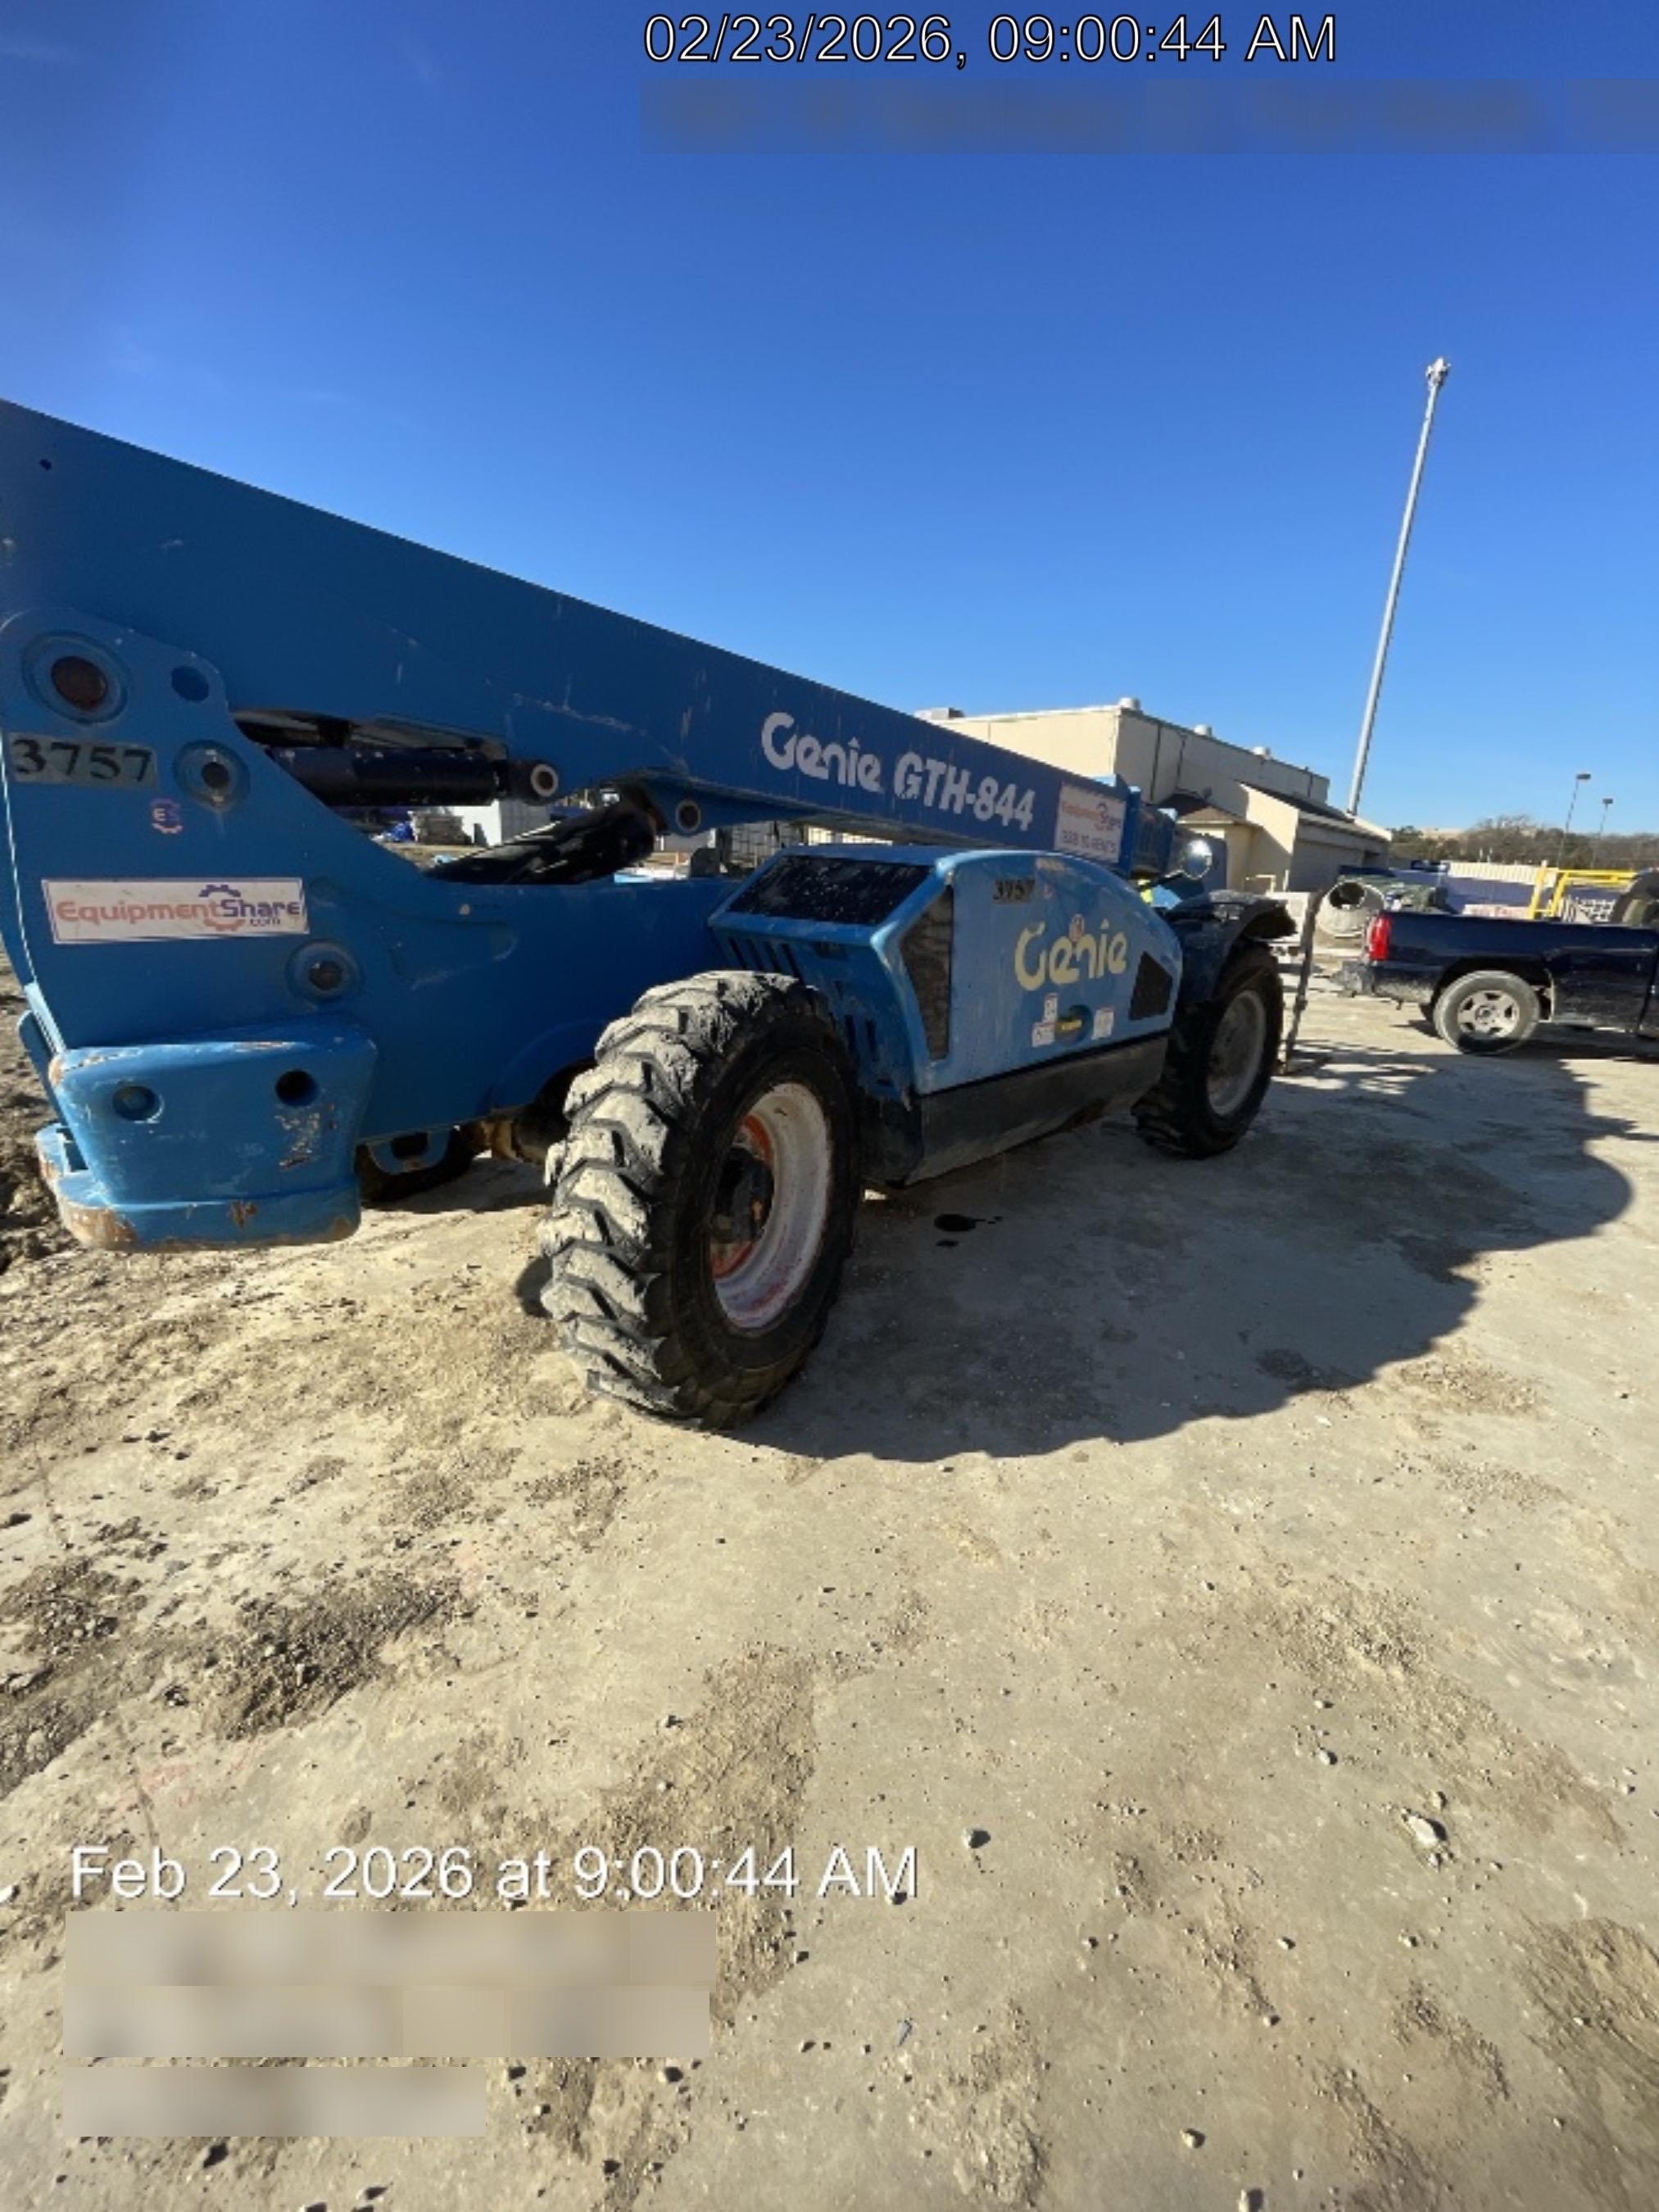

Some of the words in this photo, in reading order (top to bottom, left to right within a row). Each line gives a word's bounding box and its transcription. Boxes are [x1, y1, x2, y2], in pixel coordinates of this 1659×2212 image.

[11, 739, 153, 783] 3757
[761, 711, 885, 794] Genie
[894, 751, 1036, 832] GTH-844
[56, 899, 301, 925] EquipmentShare
[1014, 918, 1128, 992] Genie
